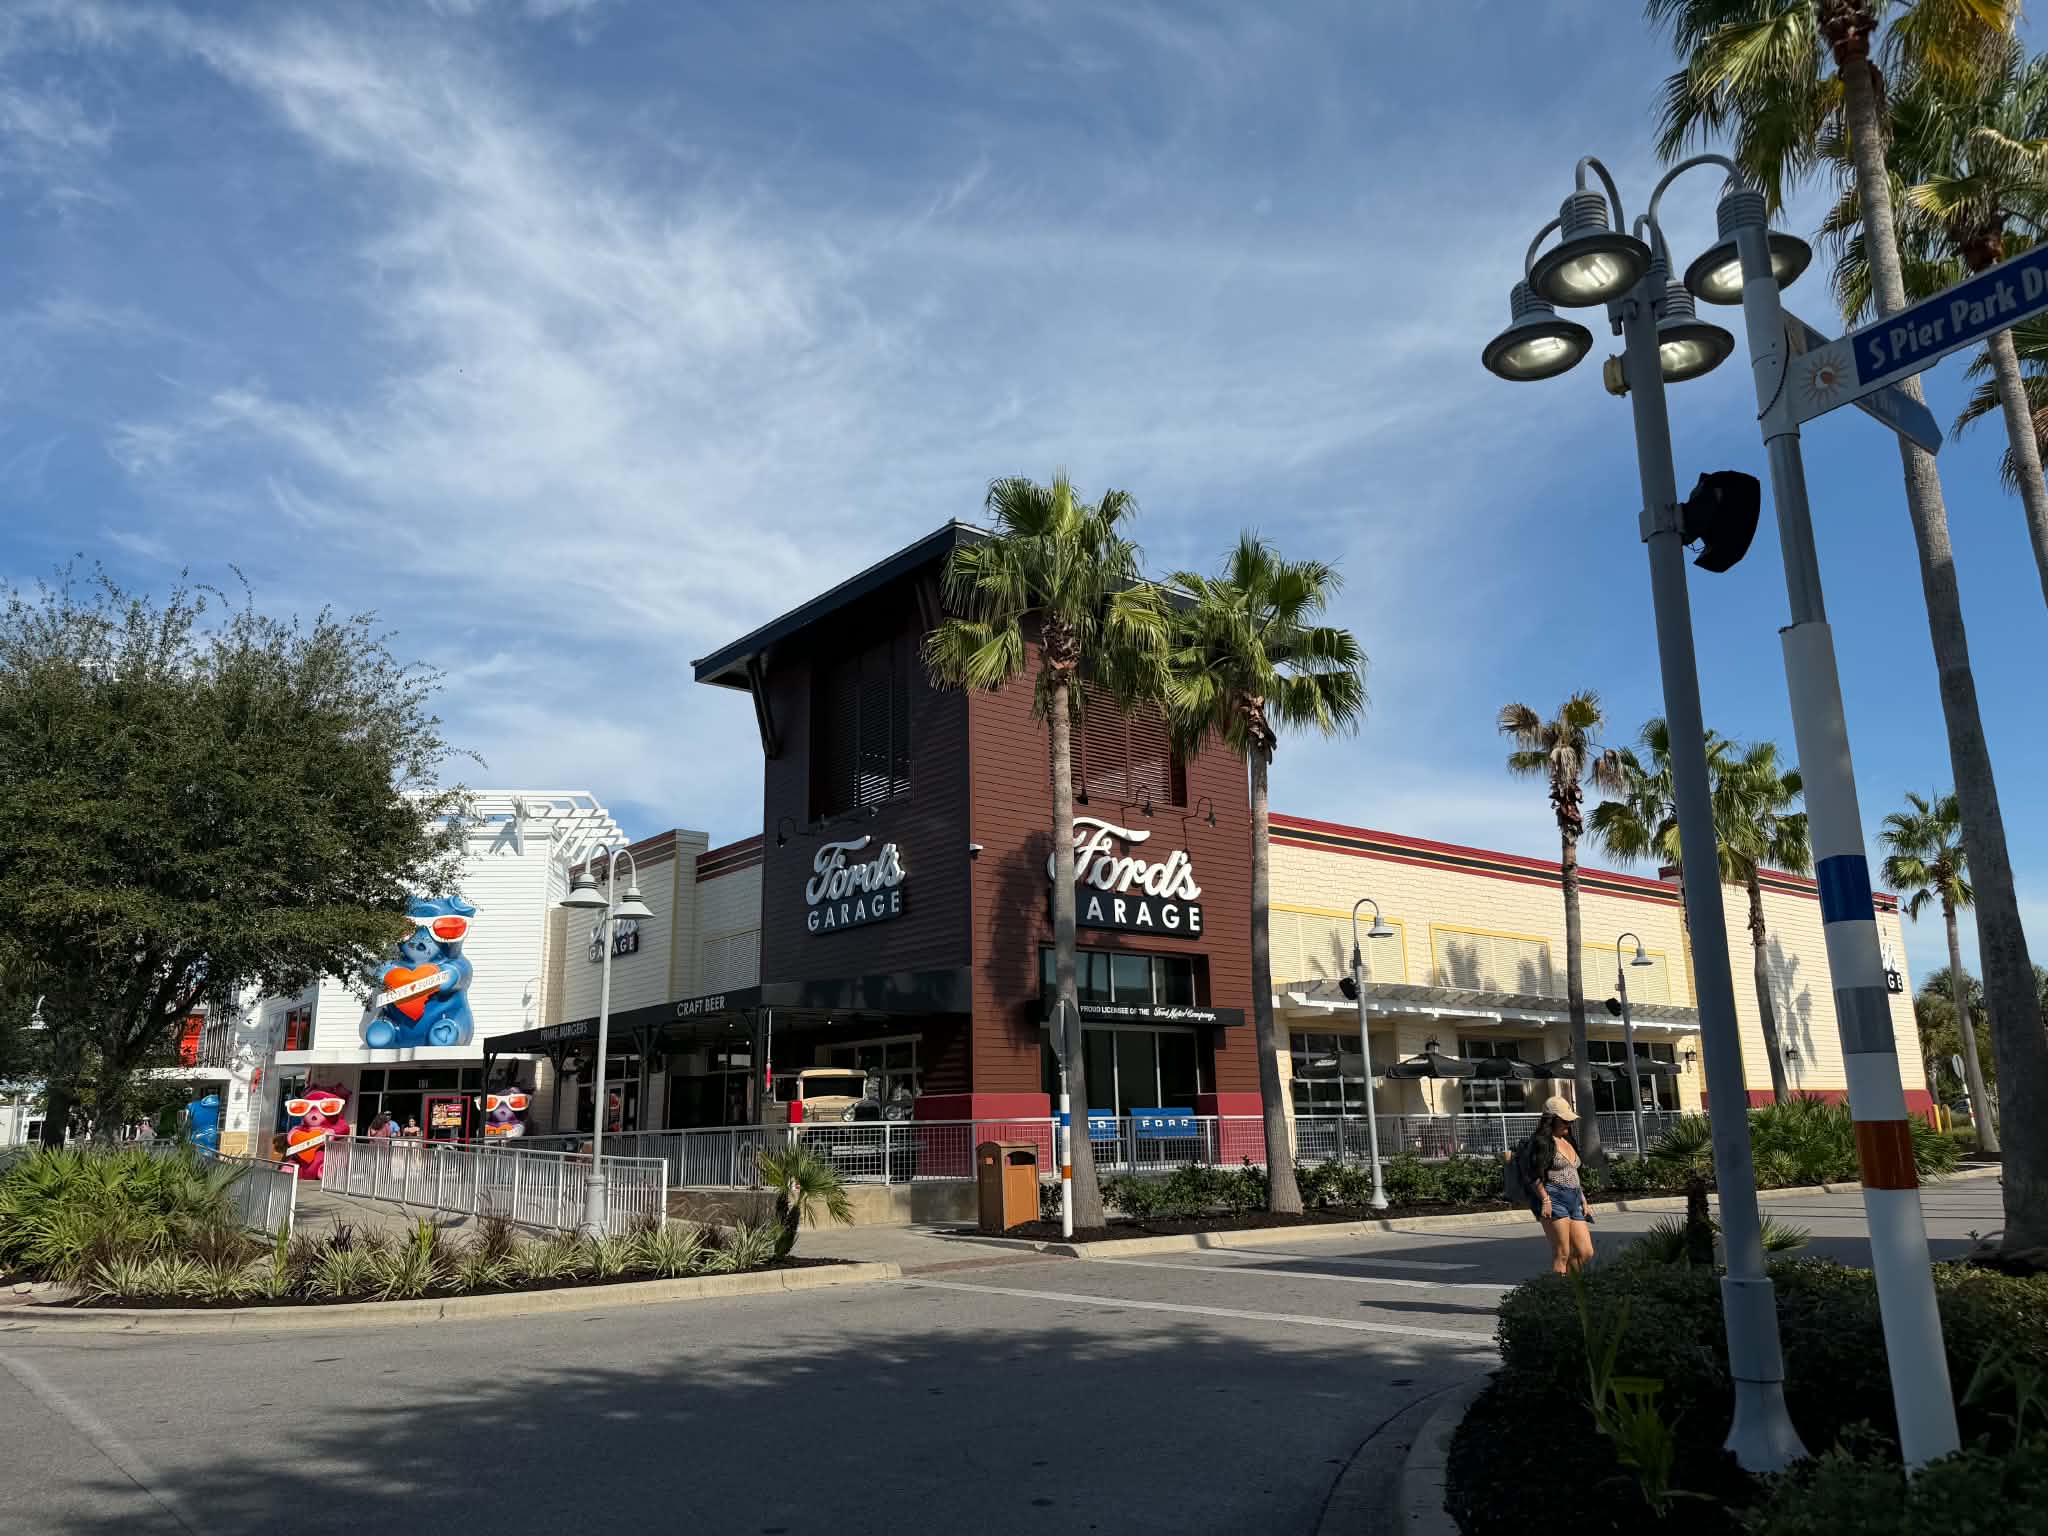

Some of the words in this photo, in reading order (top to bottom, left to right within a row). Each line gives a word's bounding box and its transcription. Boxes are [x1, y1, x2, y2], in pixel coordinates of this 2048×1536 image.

[1868, 336, 1886, 370] S
[1889, 318, 1945, 361] Pier
[1949, 280, 2017, 335] Park
[805, 835, 906, 906] Ford's
[807, 890, 901, 932] GARAGE
[1086, 896, 1201, 931] ARAGE
[589, 937, 635, 961] GAAGE
[676, 999, 704, 1017] CRAFT
[705, 995, 726, 1013] BEER
[1080, 1005, 1101, 1013] PROUD
[1101, 1006, 1129, 1014] LICENSEE
[1130, 1007, 1138, 1015] OF
[1139, 1008, 1150, 1016] THE
[1153, 1007, 1170, 1017] Ford
[1142, 1119, 1189, 1128] FORD
